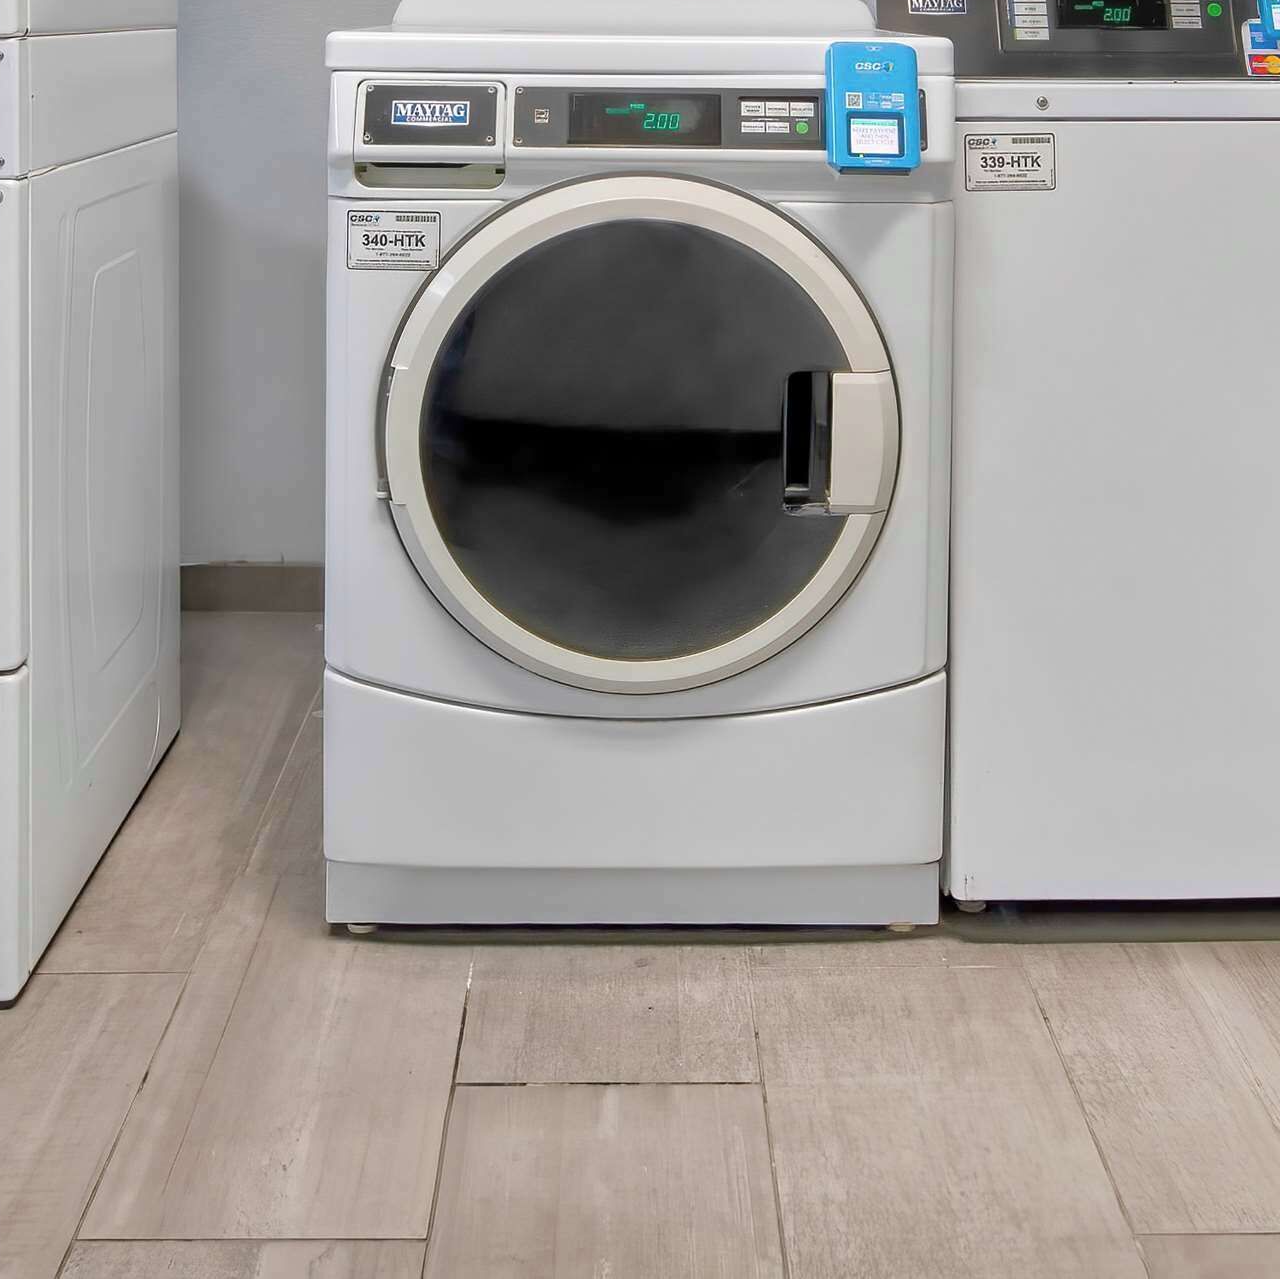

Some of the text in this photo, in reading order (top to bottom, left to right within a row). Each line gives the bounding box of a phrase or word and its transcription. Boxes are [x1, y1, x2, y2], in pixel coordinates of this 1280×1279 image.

[912, 0, 962, 8] MAYTAG
[1104, 8, 1130, 21] 2.00
[396, 103, 465, 116] MAYTAG
[644, 114, 679, 128] 2.00
[980, 156, 1041, 168] 339-HTK
[362, 234, 425, 247] 340-HTK
